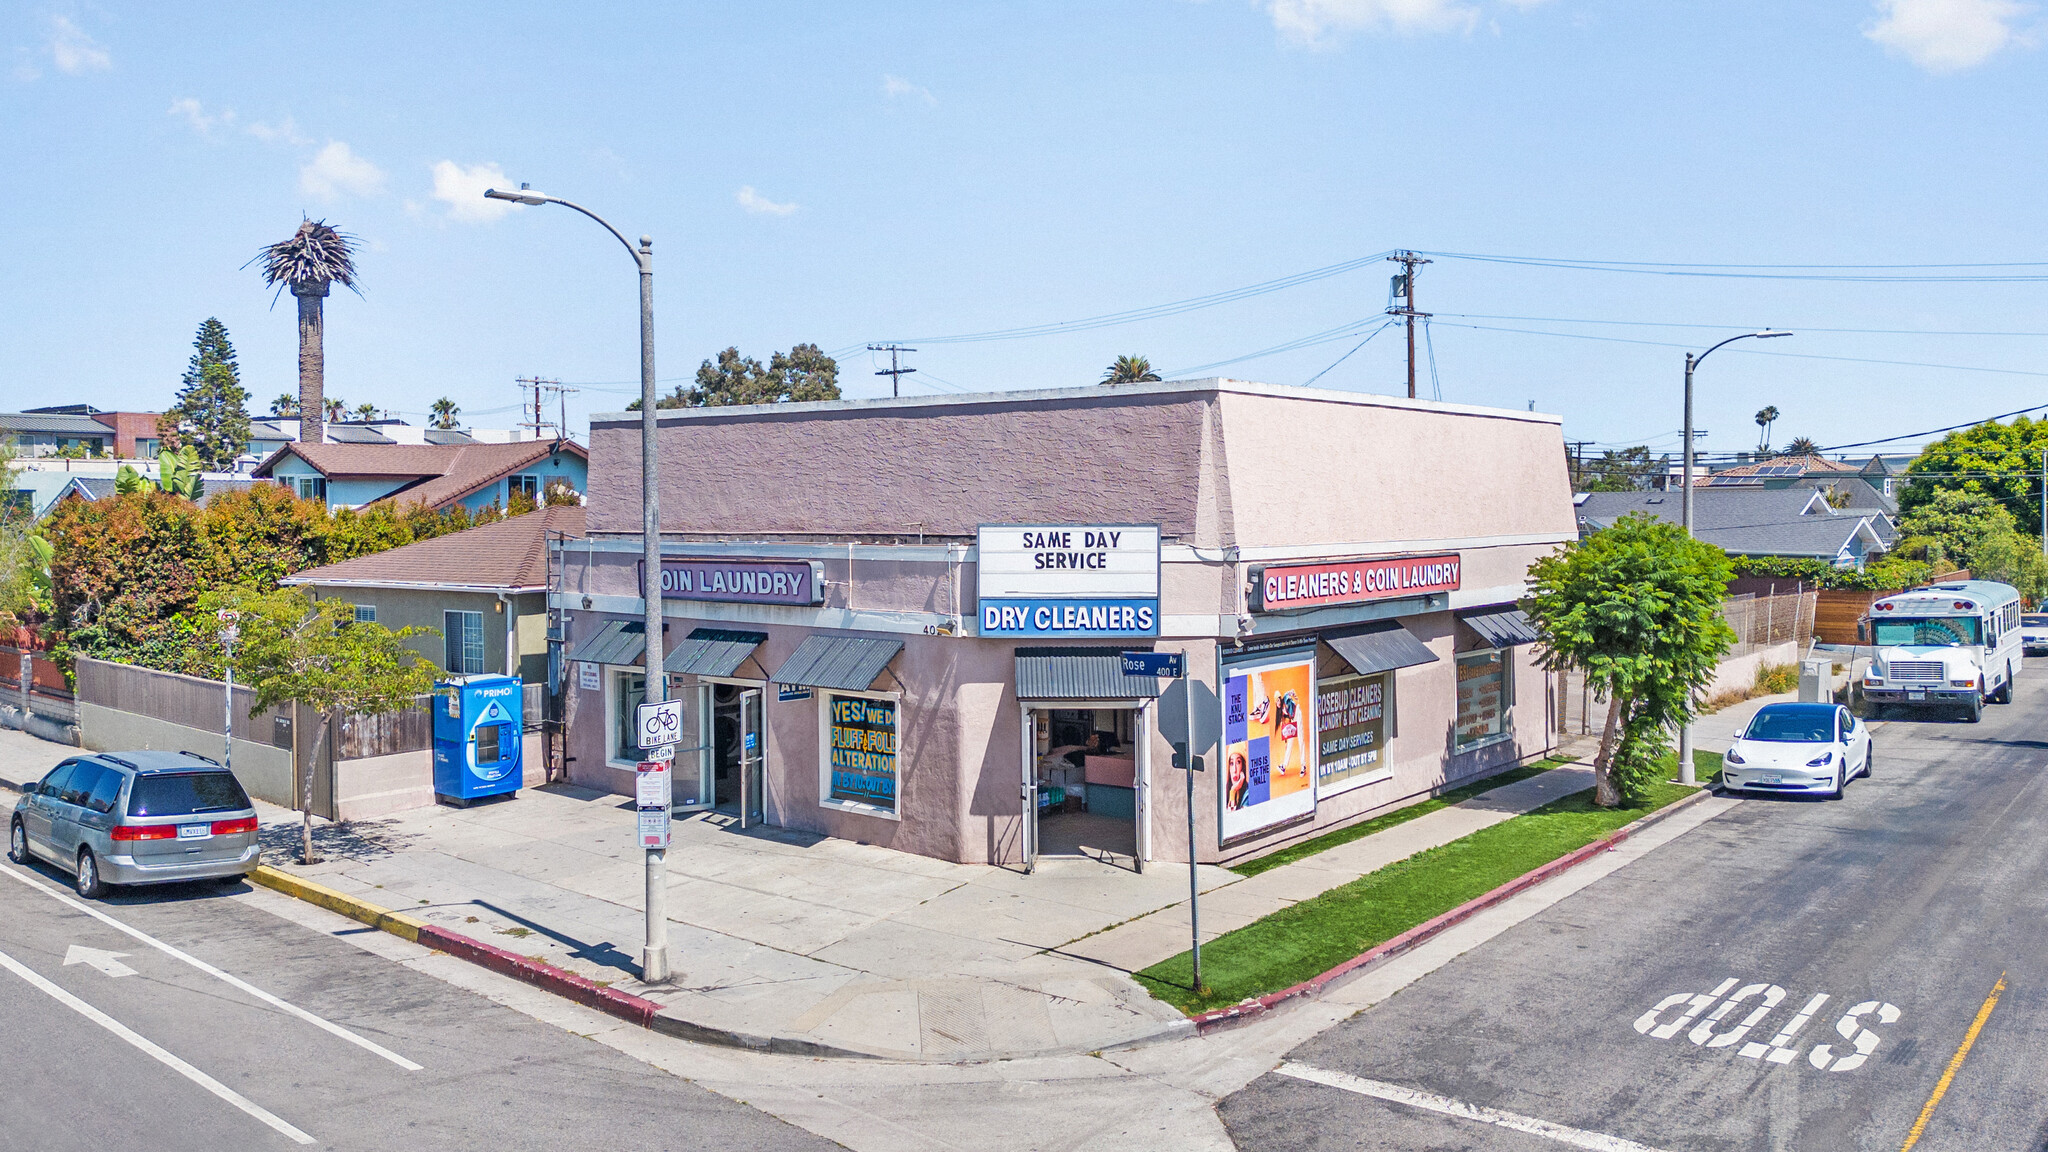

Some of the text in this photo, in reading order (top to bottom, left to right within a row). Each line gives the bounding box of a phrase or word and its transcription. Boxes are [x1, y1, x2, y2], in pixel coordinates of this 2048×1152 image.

[1023, 531, 1121, 549] SAME DAY
[1034, 552, 1107, 569] SERVICE
[660, 569, 804, 597] OIN LAUNDRY
[1265, 562, 1459, 603] CLEANERS & COIN LAUNDRY
[984, 606, 1153, 631] DRY CLEANERS
[1122, 655, 1177, 671] Rose Av
[1156, 667, 1178, 677] 400 E
[483, 687, 510, 698] PRIMO
[1231, 693, 1241, 704] THE
[1317, 682, 1382, 716] ROSEBUD CLEANERS
[832, 700, 867, 723] YES!
[866, 707, 885, 724] WE
[1231, 703, 1242, 714] KNU
[1228, 712, 1245, 725] STACK
[1318, 711, 1343, 732] LAUNDRY
[1348, 708, 1358, 725] DRY
[1358, 703, 1382, 723] CLEANING
[646, 732, 677, 745] BIKE LANE
[831, 725, 865, 750] FLUFF
[867, 729, 896, 754] FOLD
[1322, 730, 1374, 755] SAME DAY SERVICES
[650, 748, 672, 759] BEGIN
[1250, 755, 1268, 768] THIS IS
[1250, 764, 1269, 778] OFF THE
[1320, 764, 1327, 778] IN
[1367, 749, 1378, 764] 5PM
[842, 772, 855, 788] BY
[865, 776, 881, 793] OUT
[1253, 775, 1266, 786] WALL
[1633, 977, 1901, 1072] STOP
